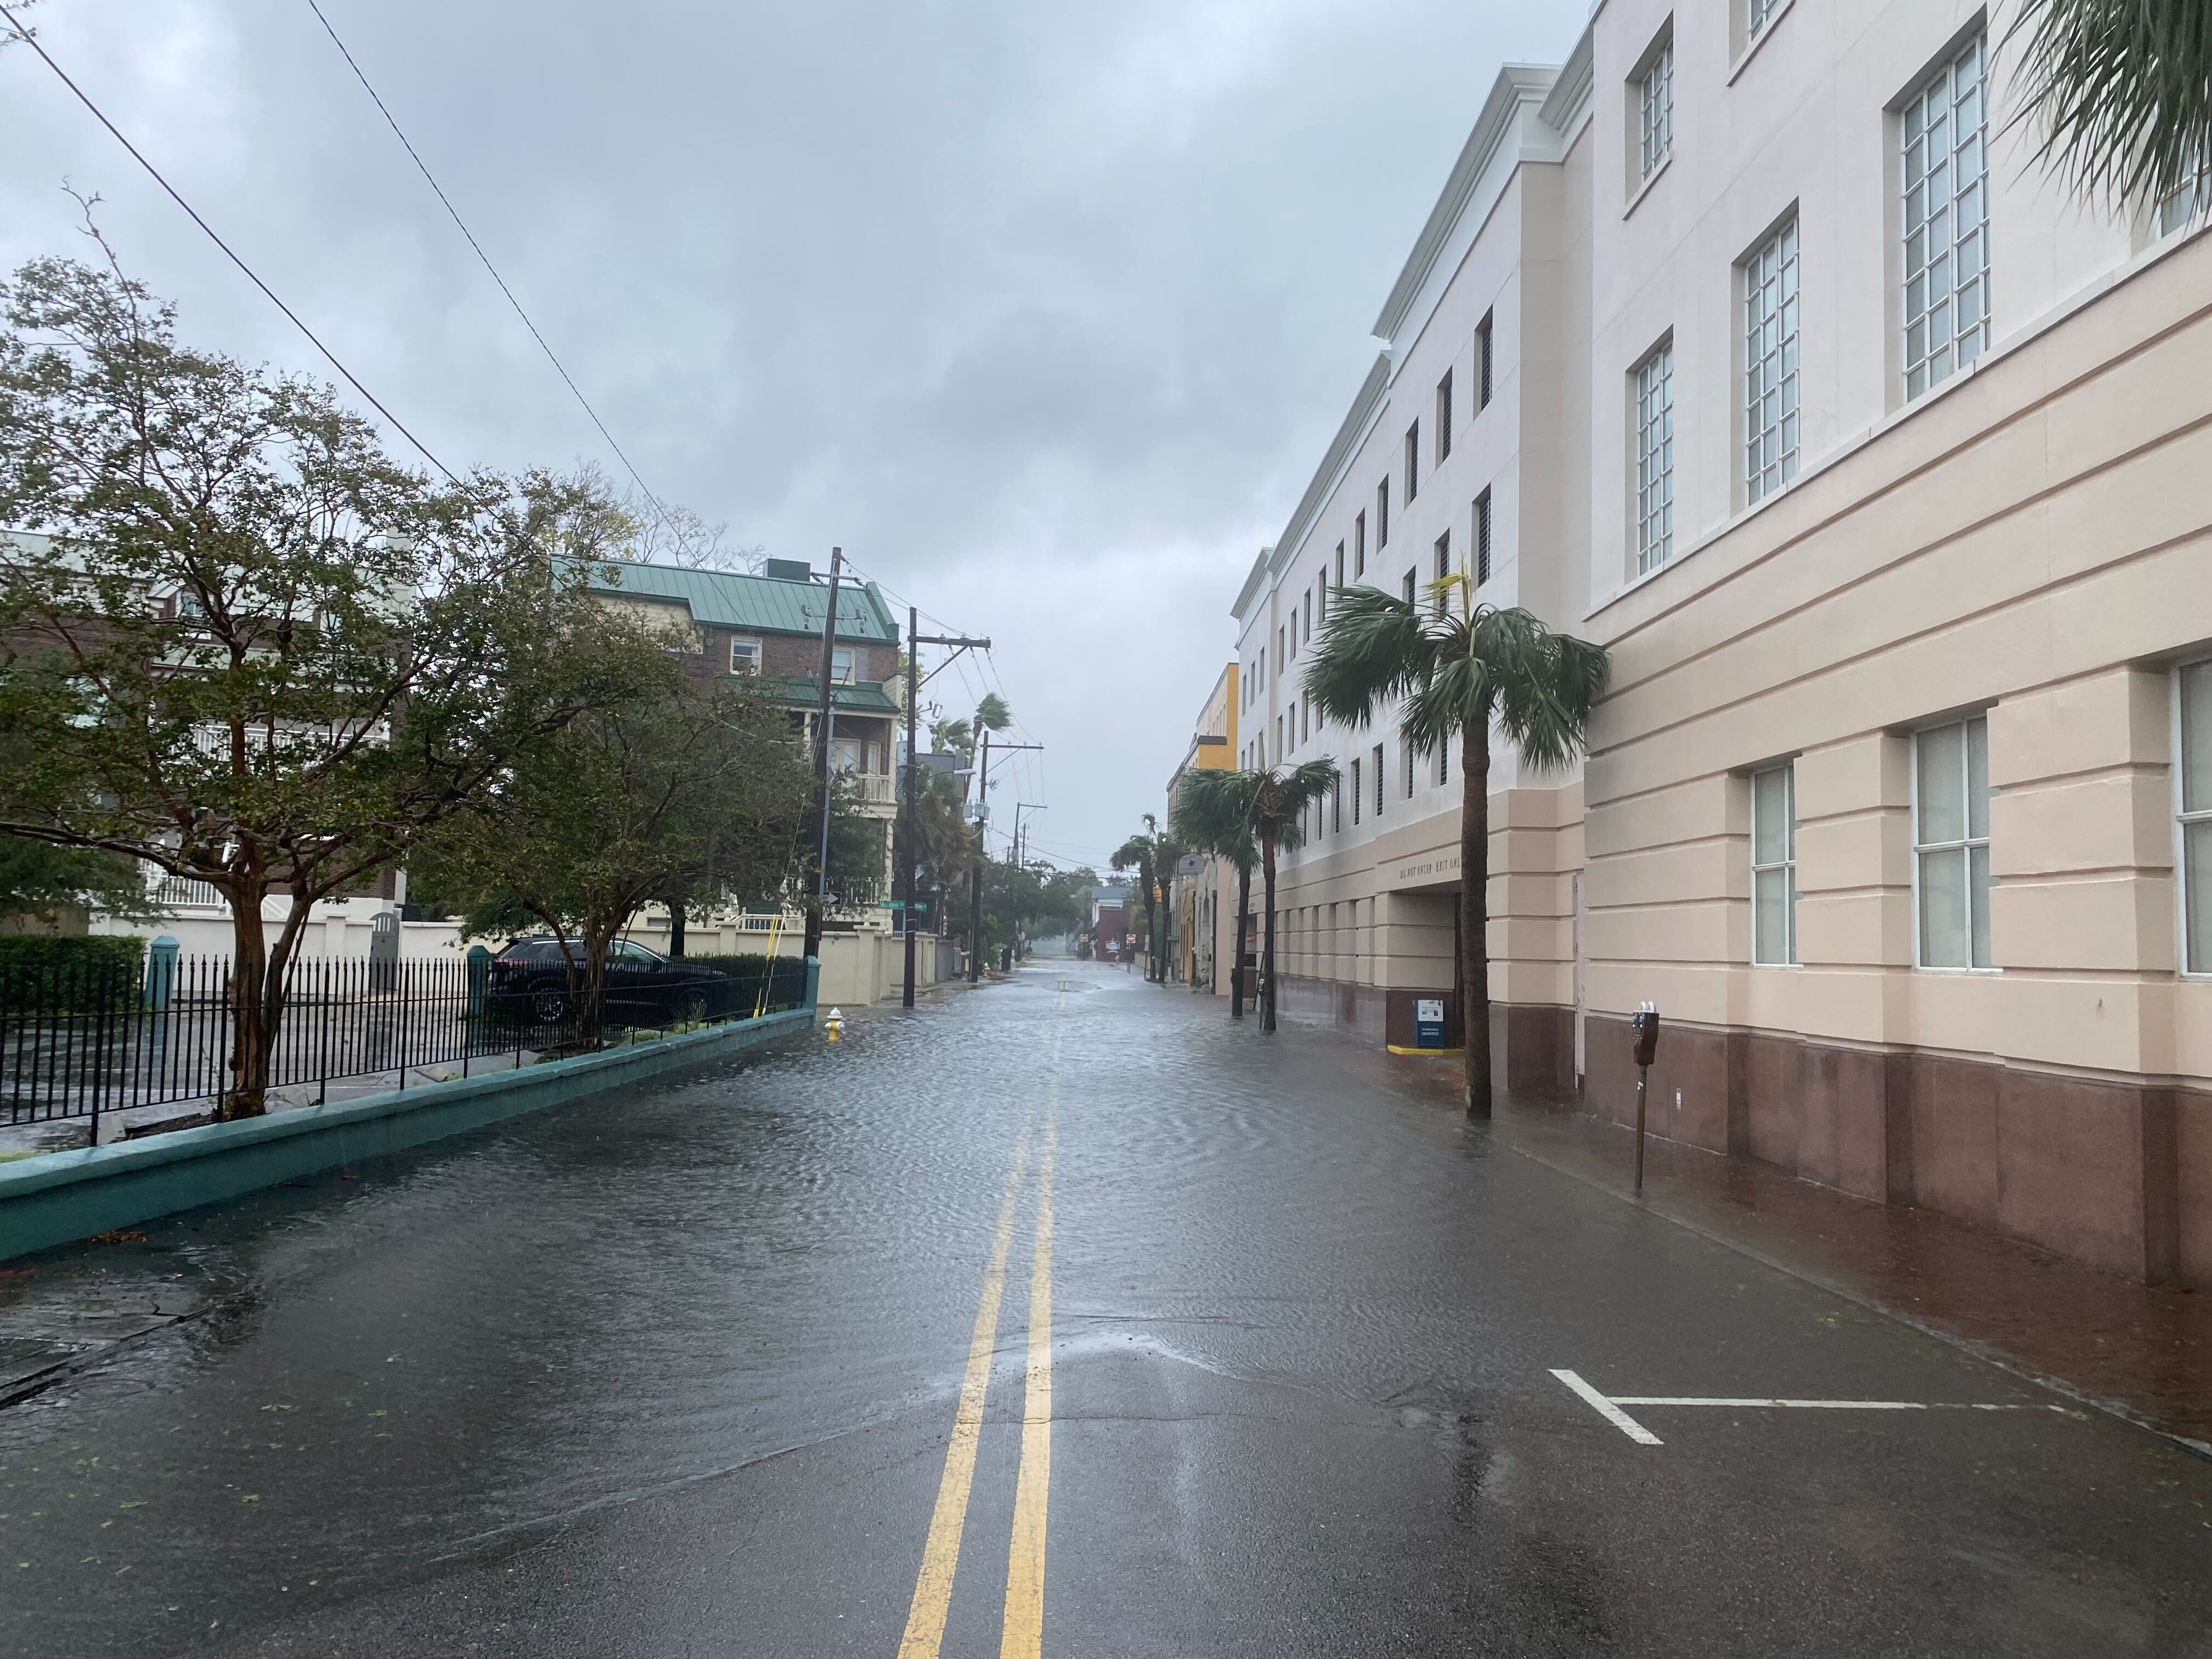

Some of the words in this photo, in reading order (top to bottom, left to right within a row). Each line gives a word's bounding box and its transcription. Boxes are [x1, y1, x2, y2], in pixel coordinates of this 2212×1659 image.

[1400, 870, 1406, 879] DO
[1418, 864, 1432, 876] ENTER
[1436, 860, 1448, 872] EXIT
[1450, 857, 1460, 869] ONL
